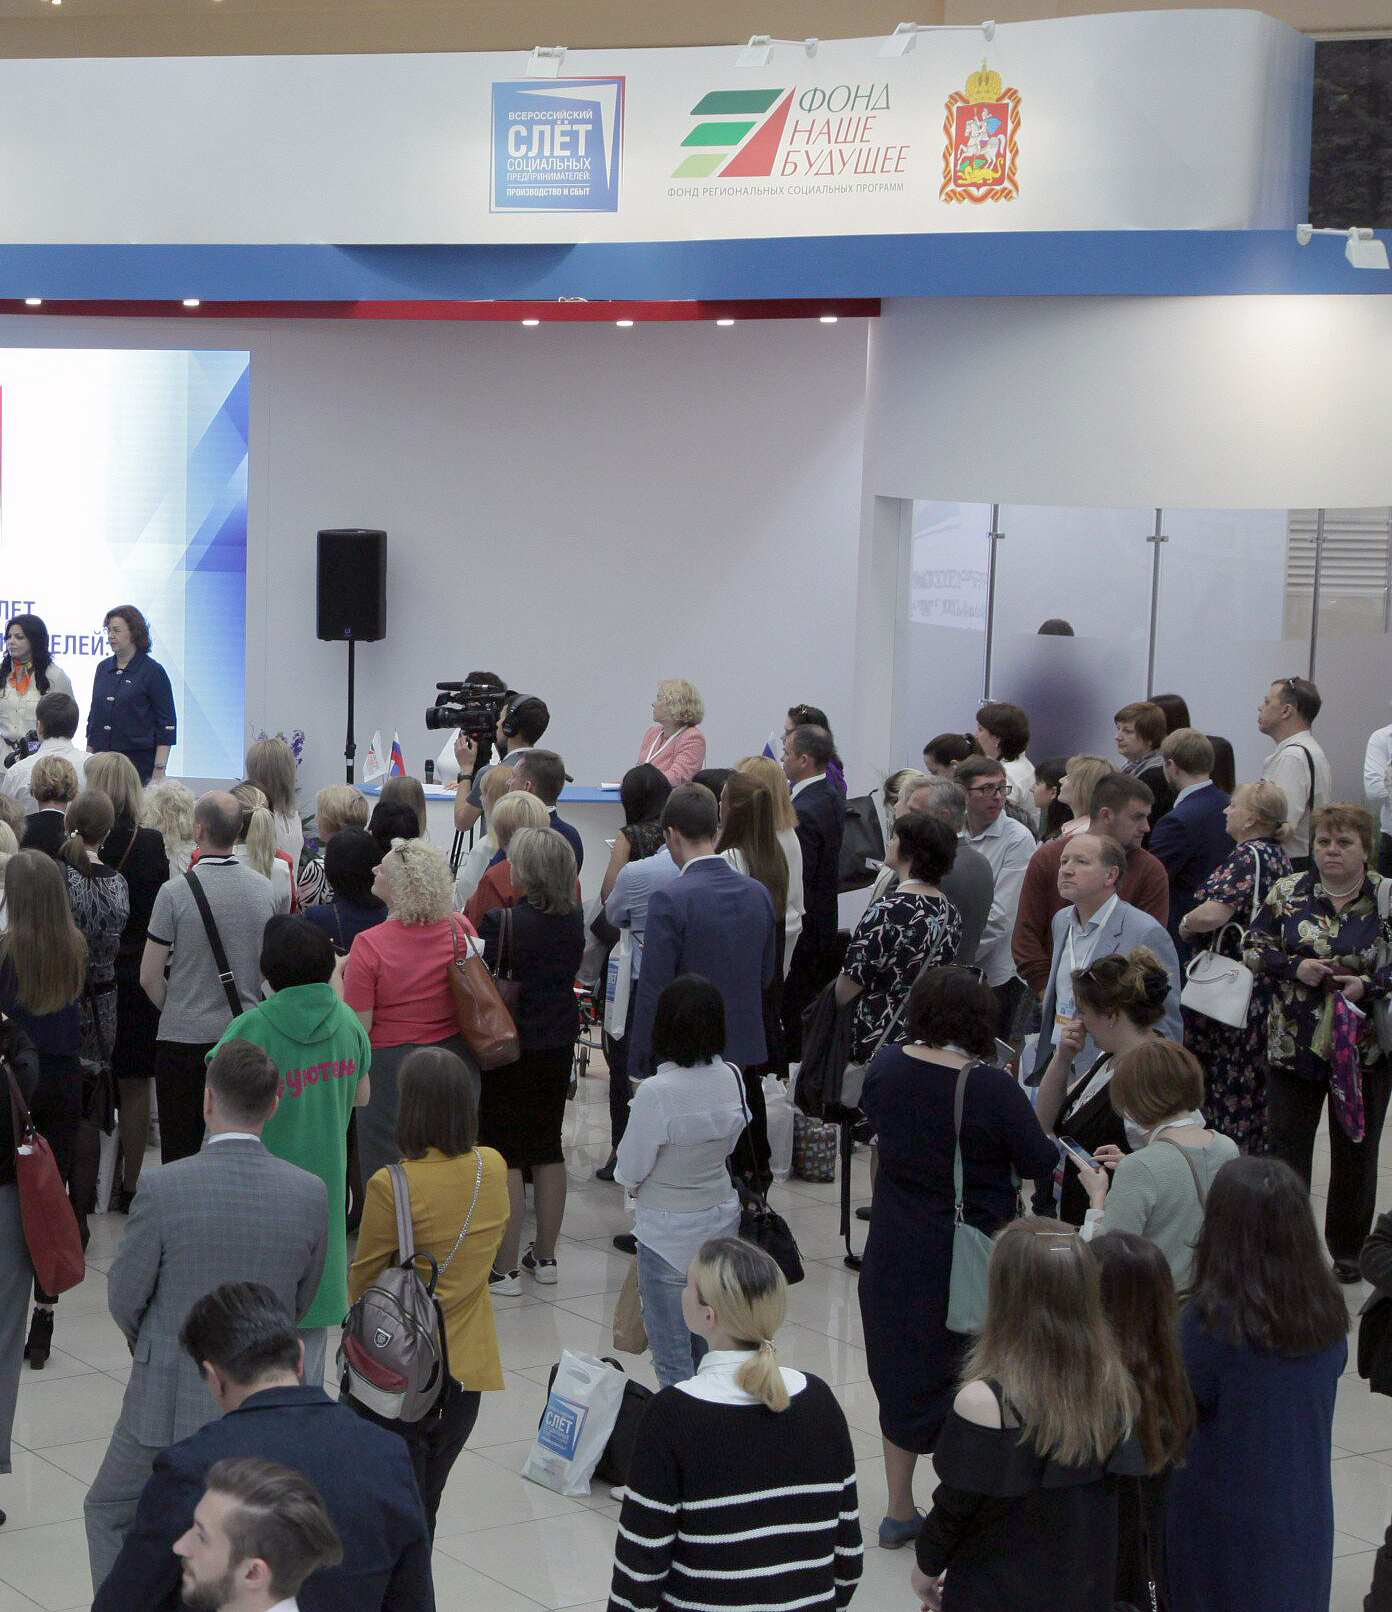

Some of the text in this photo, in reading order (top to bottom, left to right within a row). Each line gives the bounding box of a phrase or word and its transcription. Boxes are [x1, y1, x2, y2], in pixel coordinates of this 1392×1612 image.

[799, 83, 890, 113] ФОНД
[508, 109, 593, 120] ВСЕРОССИЙСКИЙ
[508, 120, 592, 157] СЛЁТ
[789, 116, 876, 146] НАШЕ
[508, 158, 592, 172] СОЦИАЛЬНЫХ
[780, 146, 910, 177] БУДУЩЕЕ
[507, 187, 591, 197] ПРОИЗВОДСТВО И СБЫТ
[667, 182, 904, 198] ФОНД РЕГИОНАЛЬНЫХ СОЦИАЛЬНЫХ ПРОГРАММ
